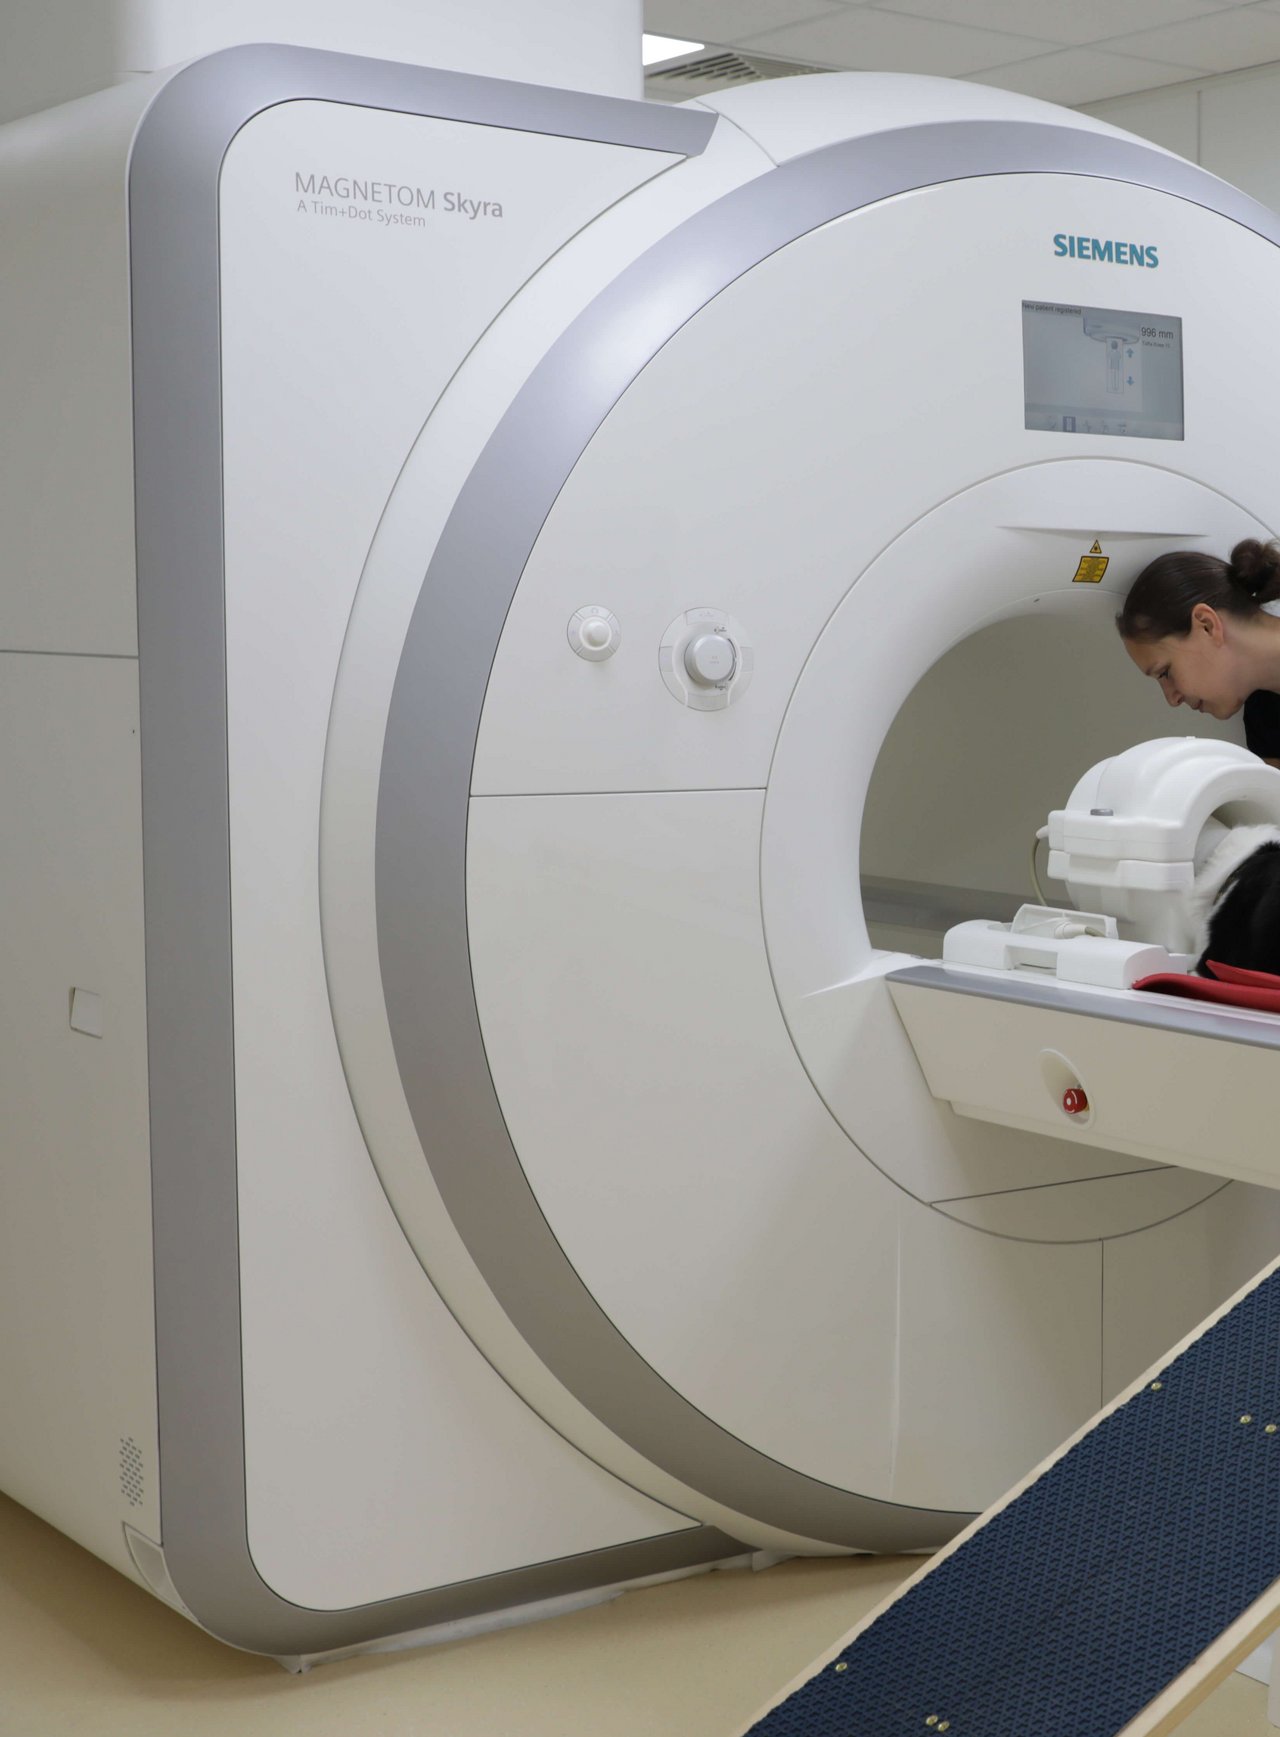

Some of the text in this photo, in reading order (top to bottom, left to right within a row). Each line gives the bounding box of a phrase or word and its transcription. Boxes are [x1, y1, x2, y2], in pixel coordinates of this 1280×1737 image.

[295, 171, 504, 221] MAGNETOM Skyra
[297, 199, 426, 228] A Tim+Dot System
[1053, 233, 1159, 269] SIEMENS
[1141, 326, 1174, 340] 996 mm
